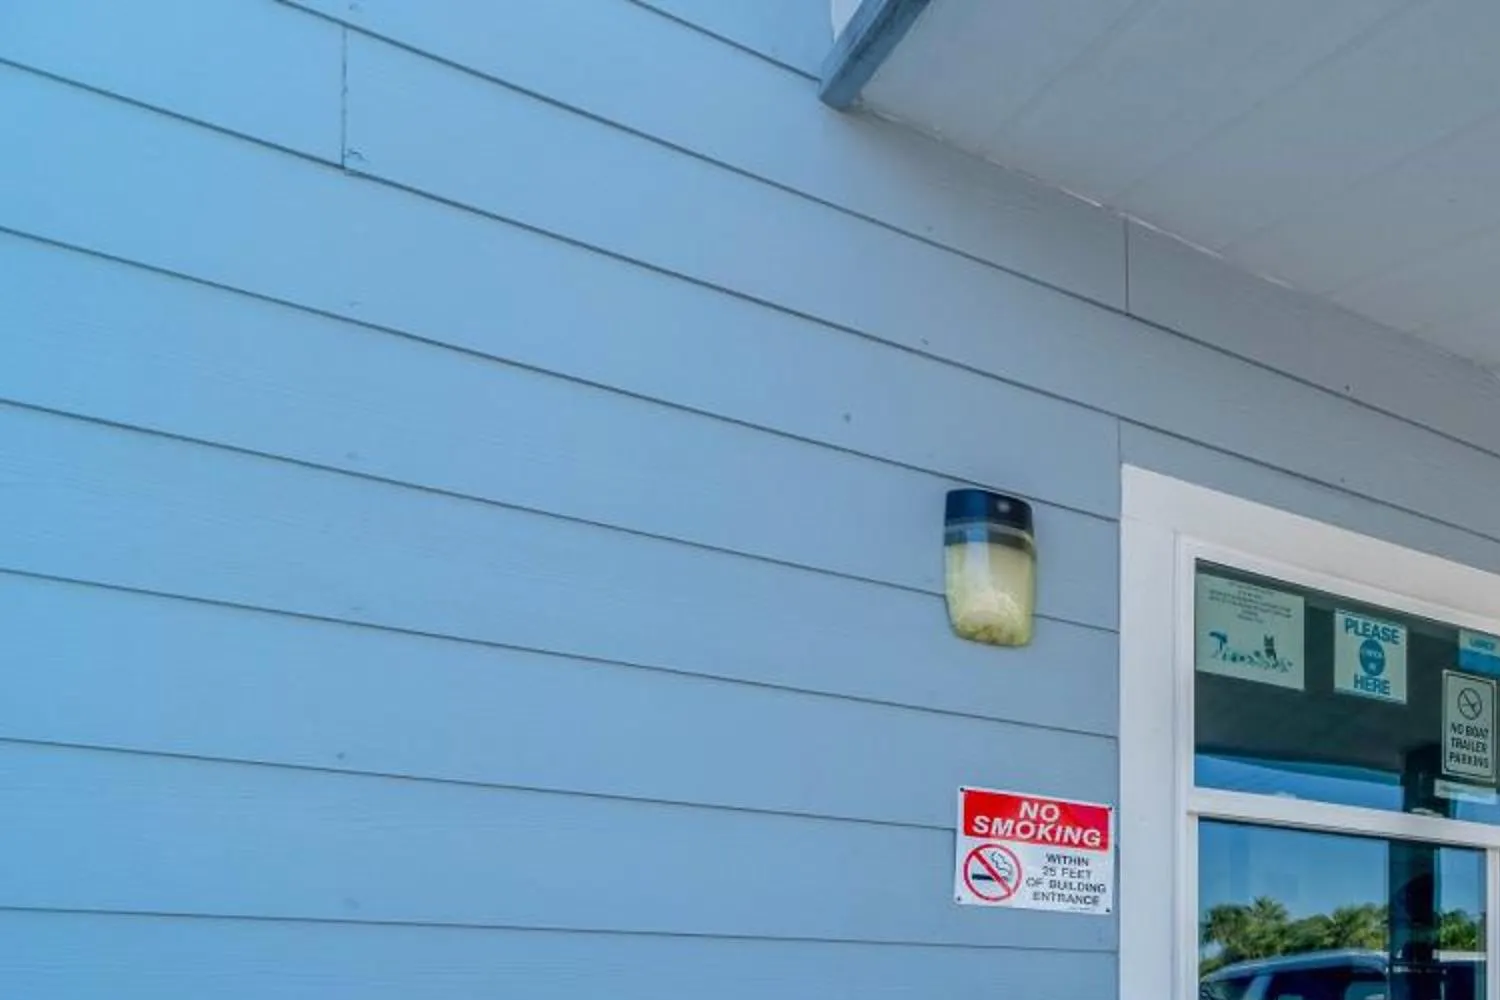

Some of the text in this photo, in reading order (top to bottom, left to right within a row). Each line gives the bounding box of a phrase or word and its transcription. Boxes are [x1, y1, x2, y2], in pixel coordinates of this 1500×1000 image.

[1344, 617, 1401, 646] PLEASE
[1353, 673, 1391, 696] HERE
[1451, 722, 1489, 740] NO BOAT
[1451, 736, 1488, 754] TRAILER
[1449, 751, 1489, 769] PARKING
[1019, 801, 1061, 823] NO
[972, 815, 1101, 847] SMOKING
[1045, 853, 1090, 867] WITHIN
[1042, 866, 1092, 880] 25 FEET
[1026, 877, 1107, 894] OF BUILDING
[1032, 890, 1101, 906] ENTRANCE
